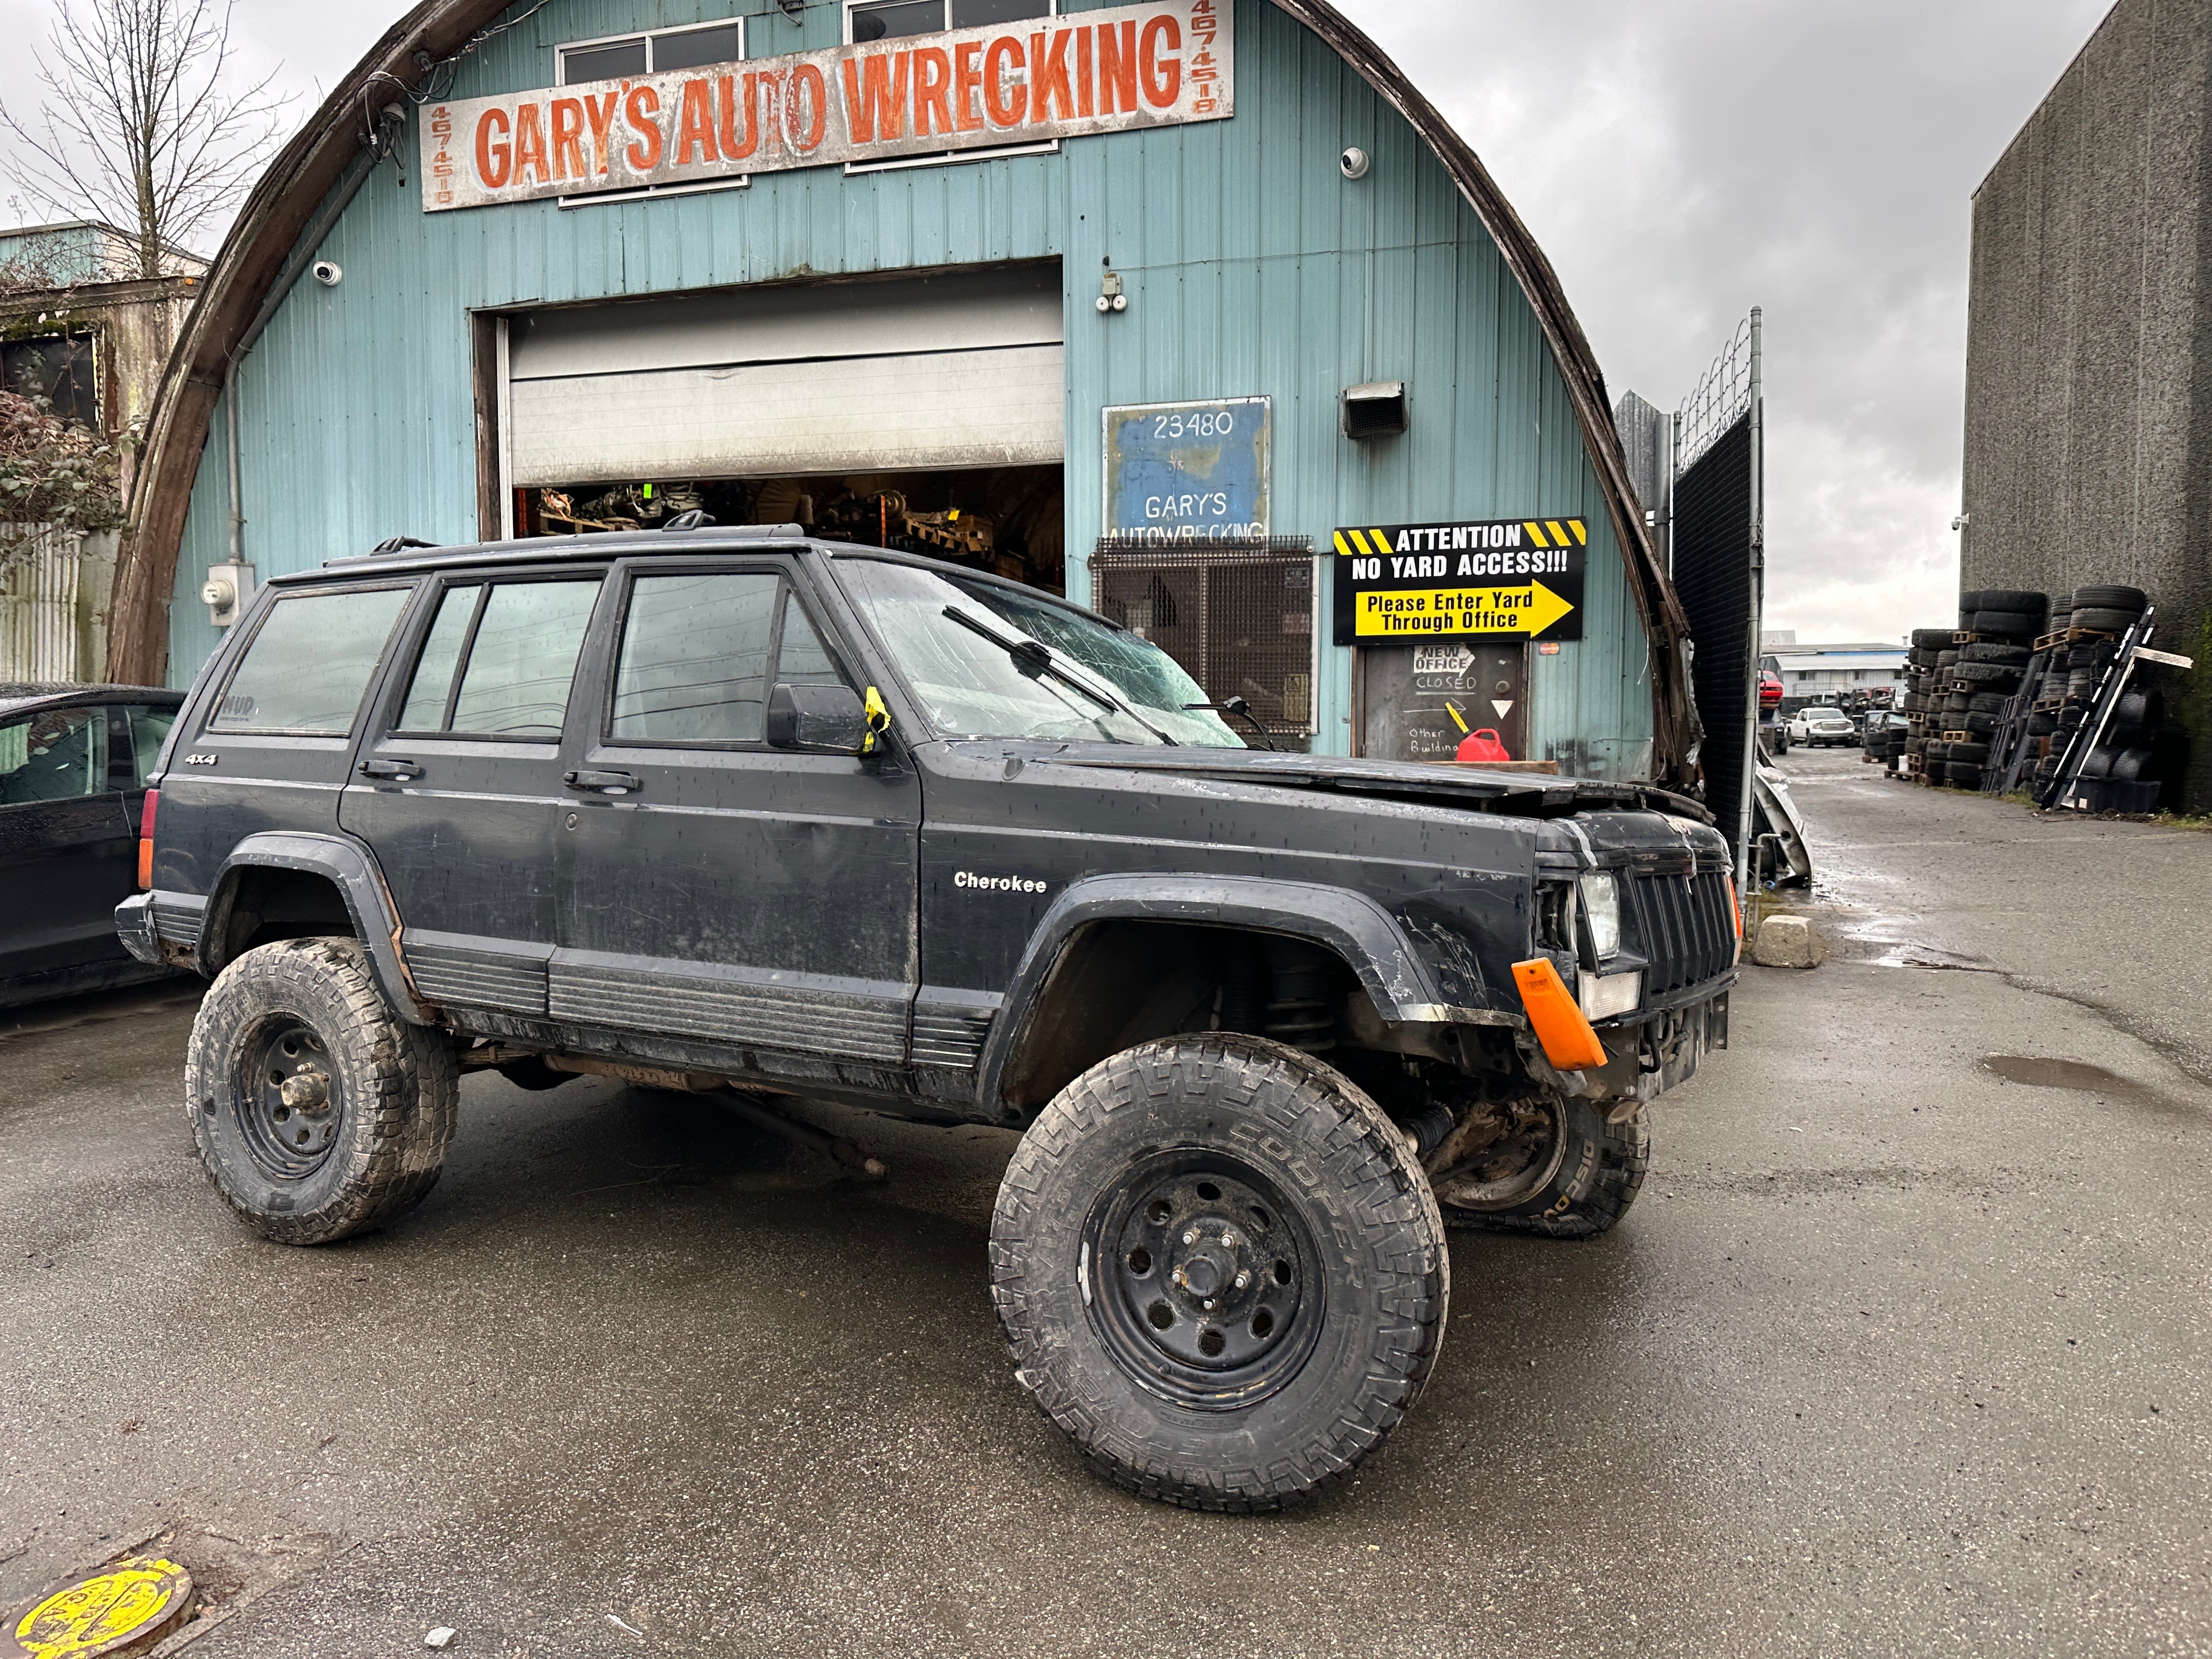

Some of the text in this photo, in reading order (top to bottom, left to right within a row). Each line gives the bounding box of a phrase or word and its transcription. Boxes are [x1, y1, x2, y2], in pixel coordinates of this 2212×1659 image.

[475, 14, 1181, 188] GARY'S AUTO WRECKING
[1154, 412, 1233, 439] 23480
[1145, 493, 1227, 518] GARY'S
[1396, 525, 1521, 552] ATTENTION
[1353, 550, 1567, 579] NO YARD ACCESS!!!
[1368, 591, 1532, 612] Please Enter Yard
[1382, 611, 1517, 632] Through Office
[1422, 646, 1459, 658] NEW
[1415, 658, 1468, 671] OFFICE
[1416, 676, 1476, 690] CLOSED
[954, 871, 1047, 893] Cherokee
[1229, 1119, 1363, 1289] COOPER
